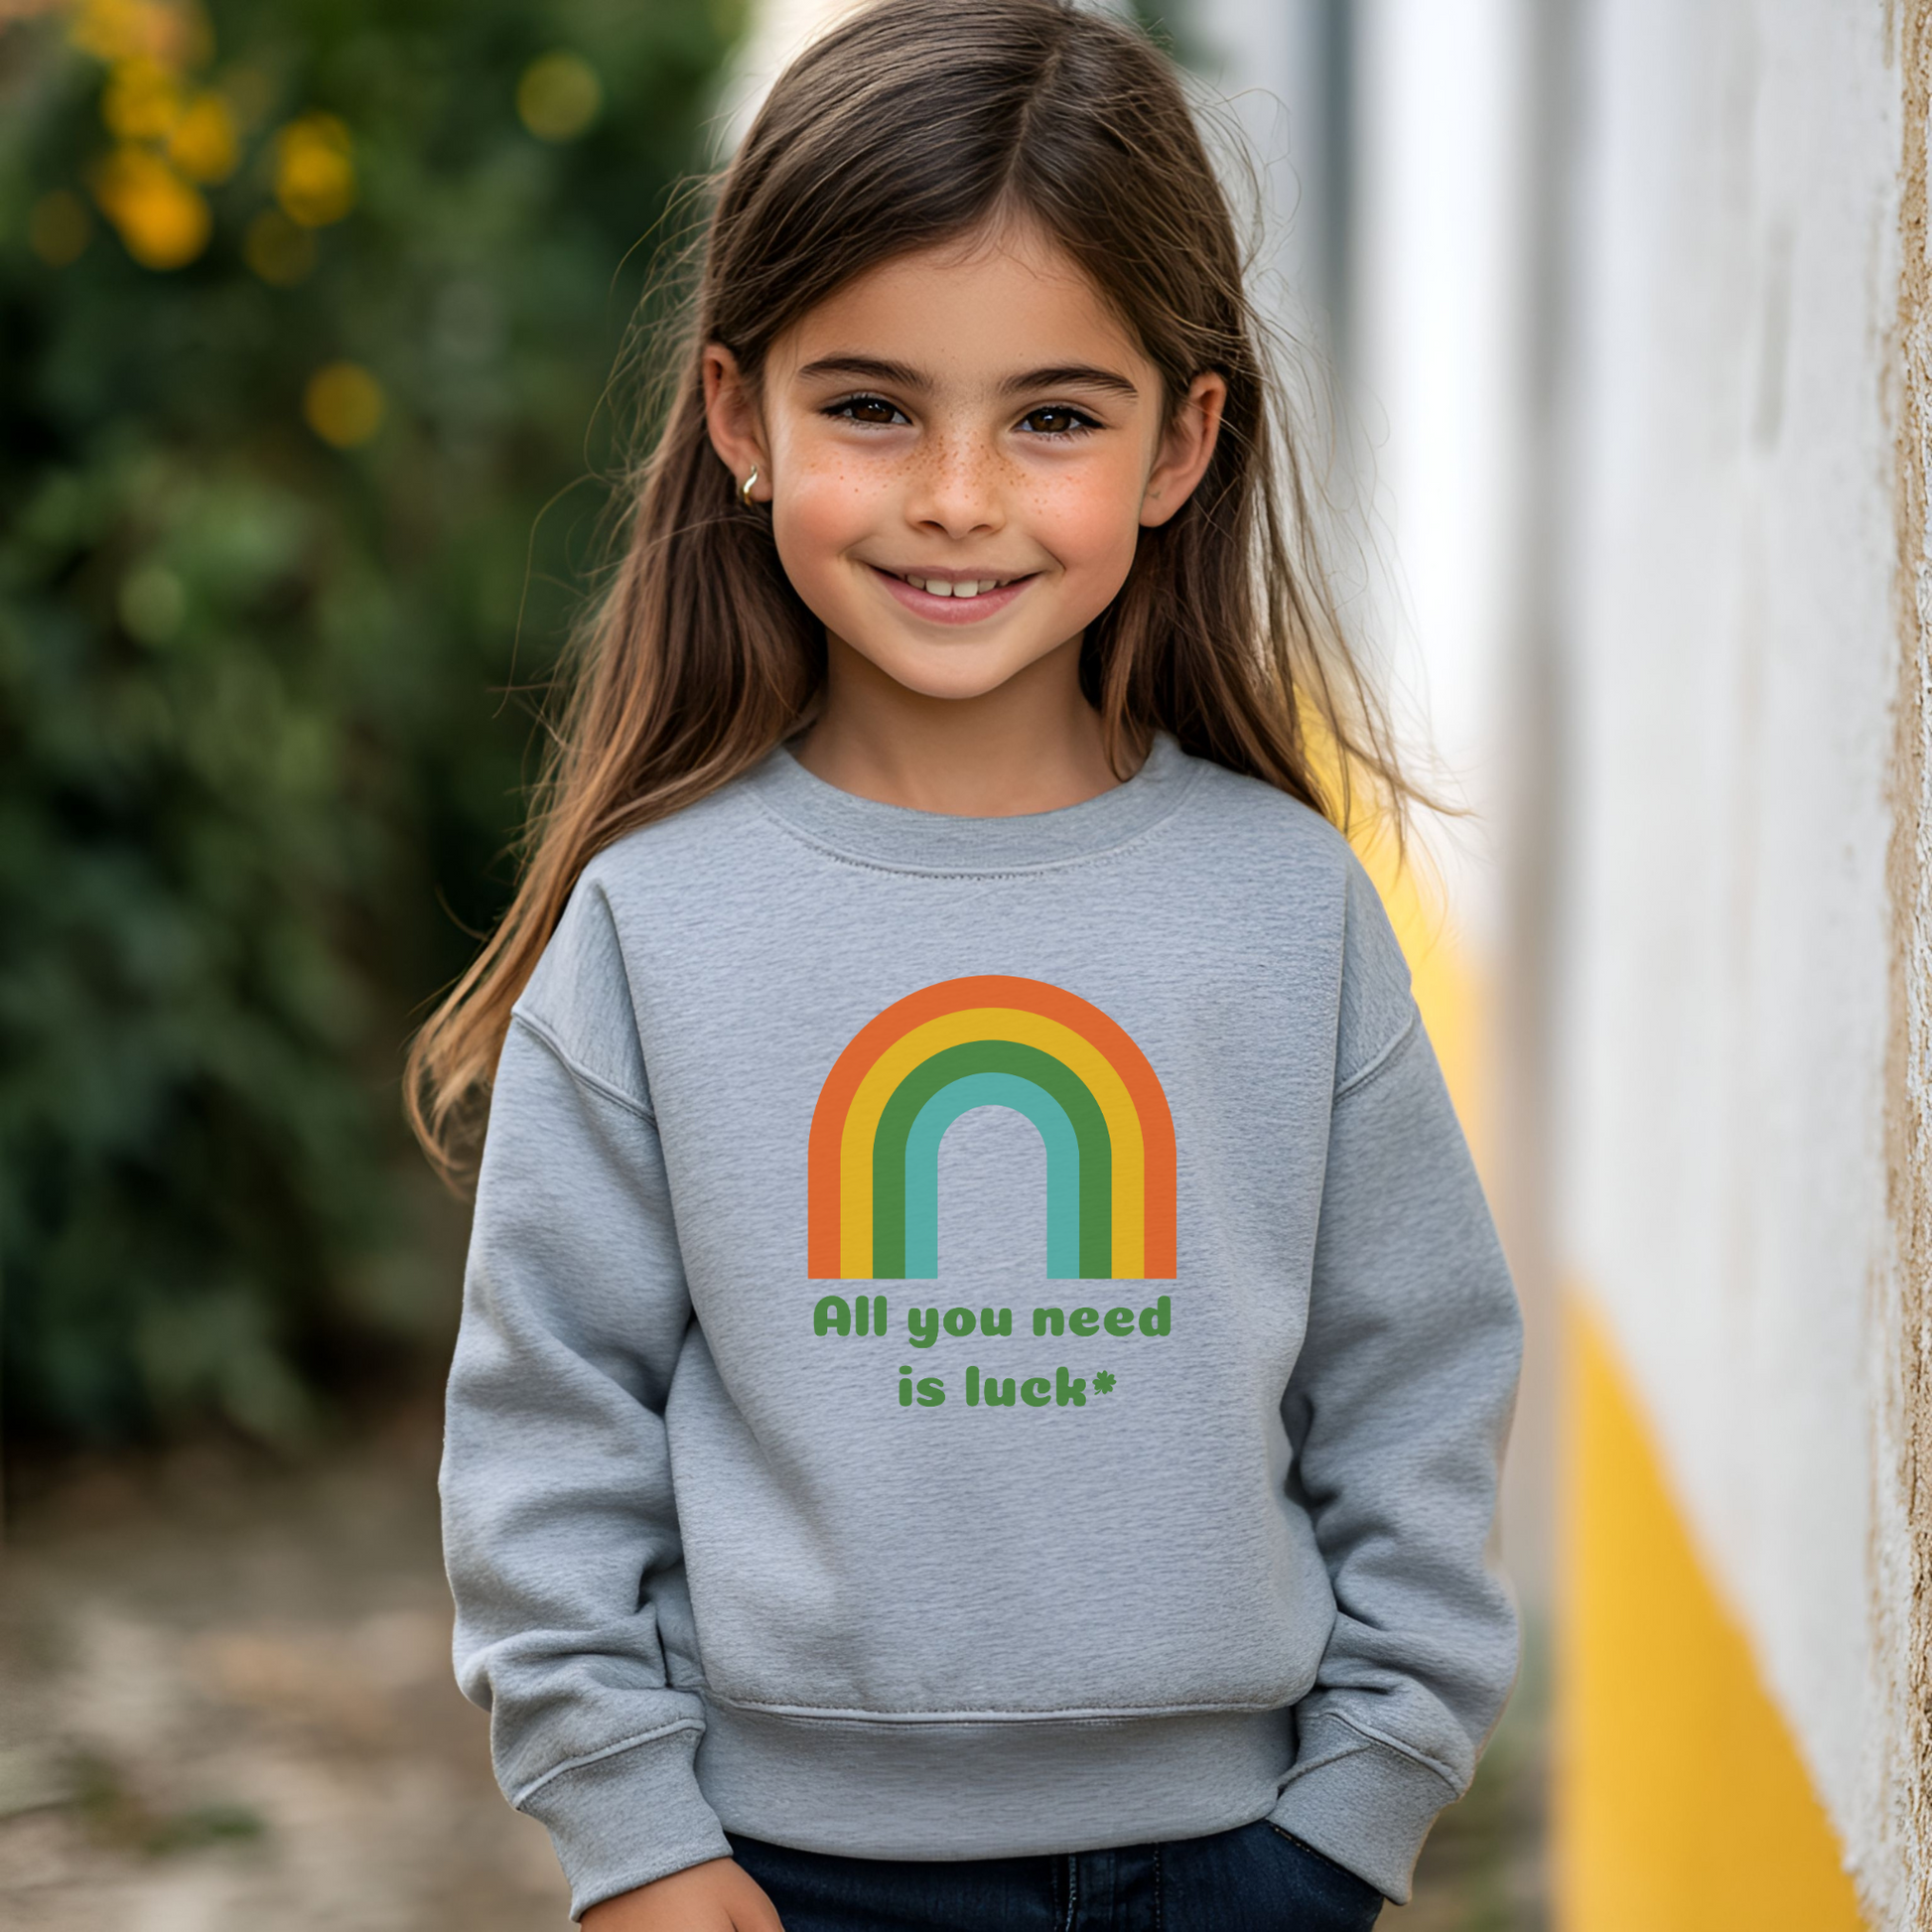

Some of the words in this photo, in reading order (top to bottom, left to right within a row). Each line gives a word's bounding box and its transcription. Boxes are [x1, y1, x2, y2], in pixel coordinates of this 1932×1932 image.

[813, 1296, 888, 1336] All
[907, 1307, 1012, 1349] you
[1033, 1296, 1172, 1337] need
[898, 1365, 946, 1407] is
[966, 1365, 1087, 1407] luck
